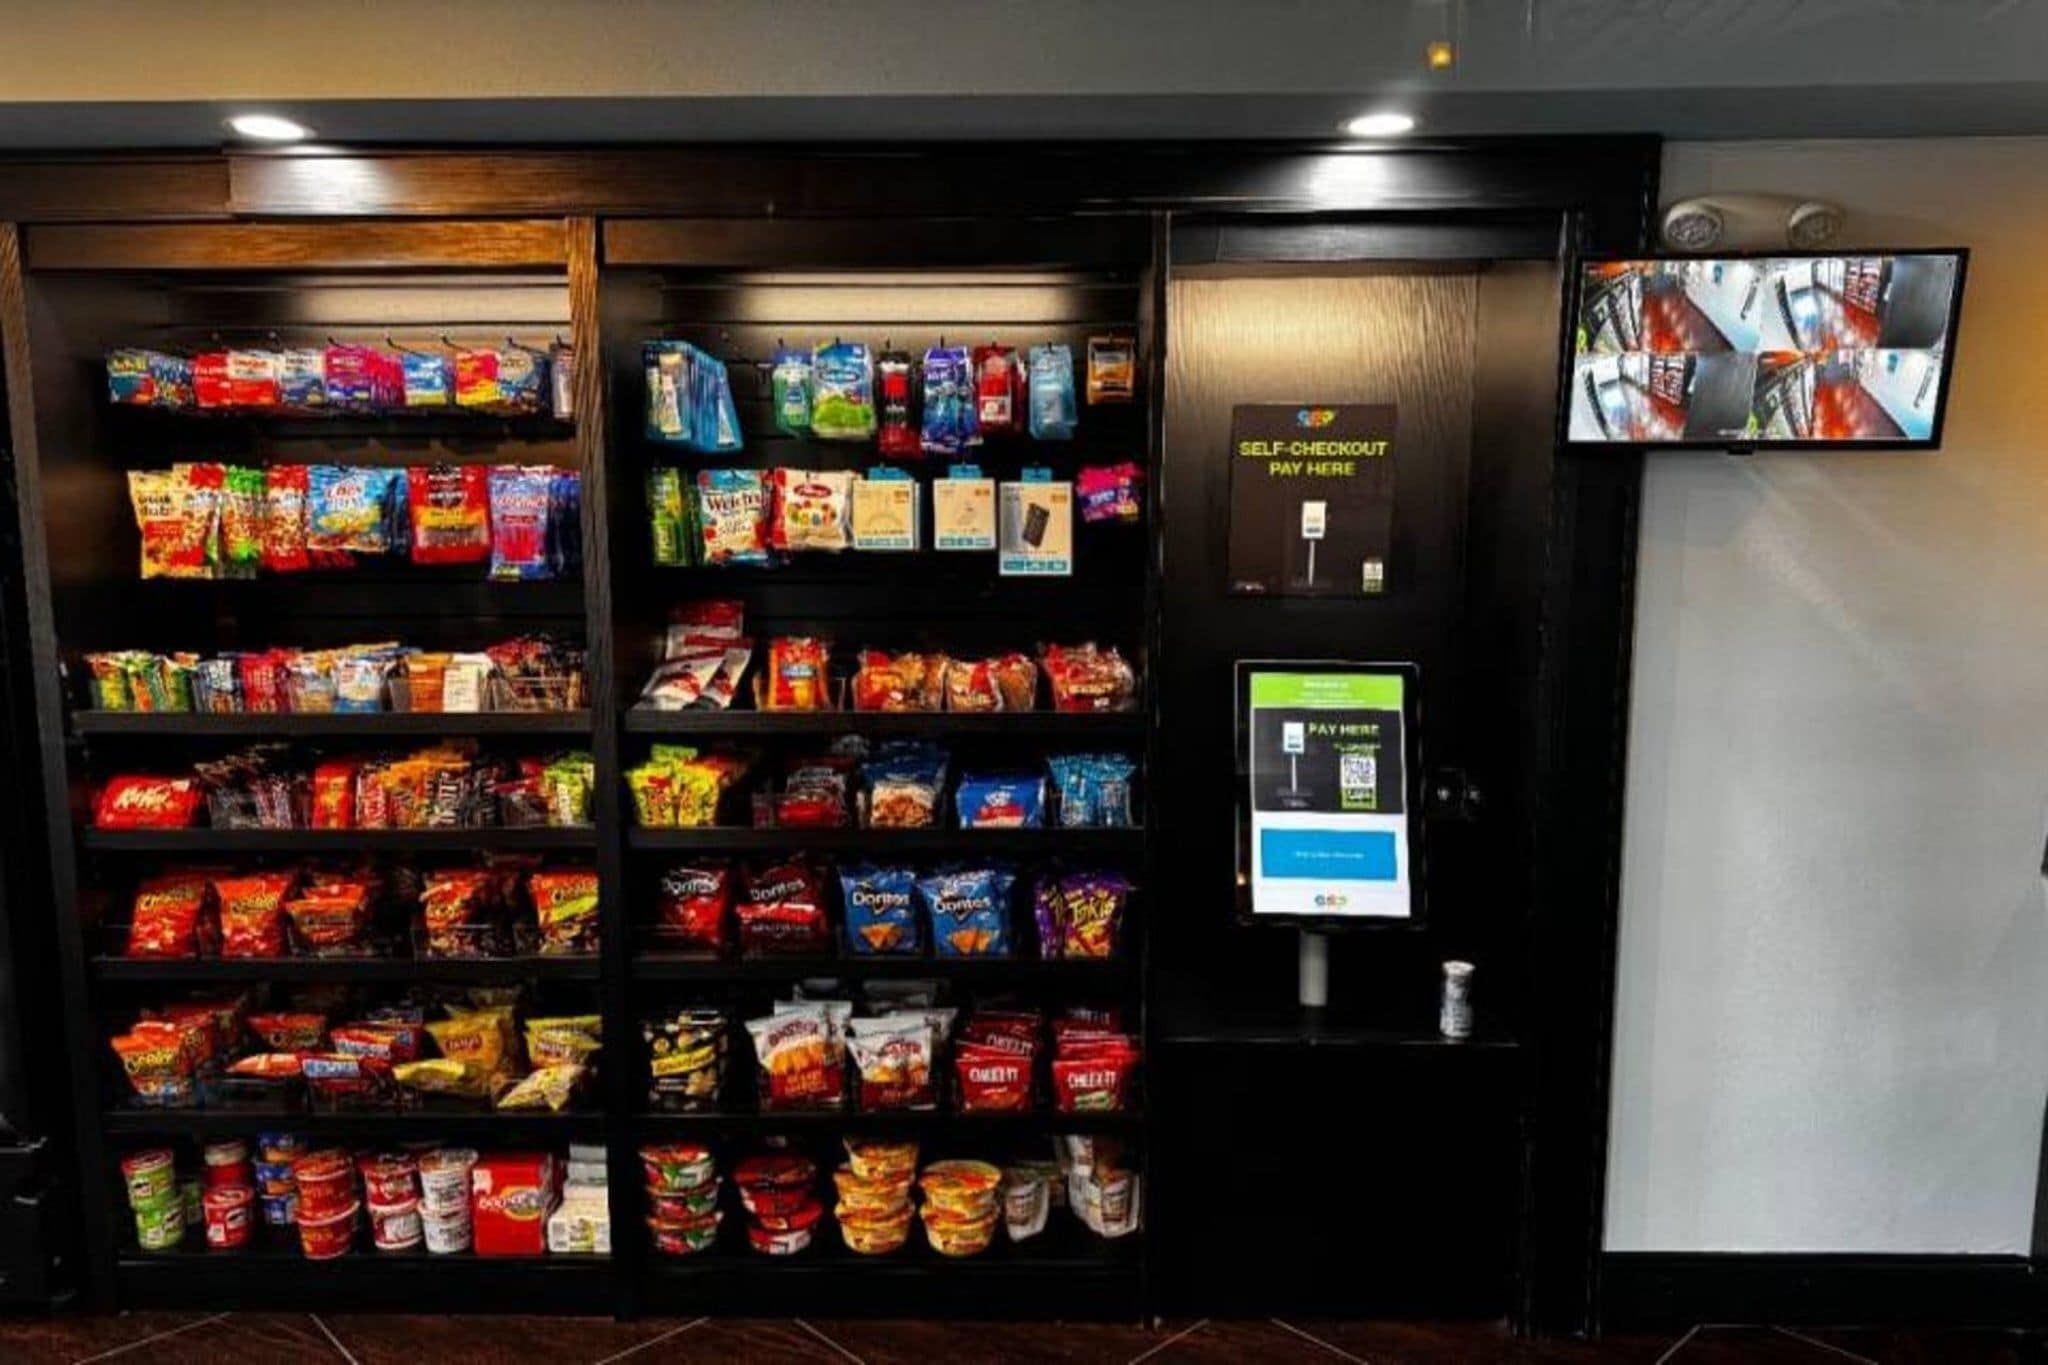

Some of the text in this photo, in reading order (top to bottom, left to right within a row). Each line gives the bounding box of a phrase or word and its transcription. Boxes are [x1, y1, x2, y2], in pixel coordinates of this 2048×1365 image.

[1239, 441, 1388, 456] SELF-CHECKOUT
[1269, 462, 1356, 475] PAY HERE
[1308, 723, 1380, 736] PAY HERE
[852, 891, 910, 907] Doritos
